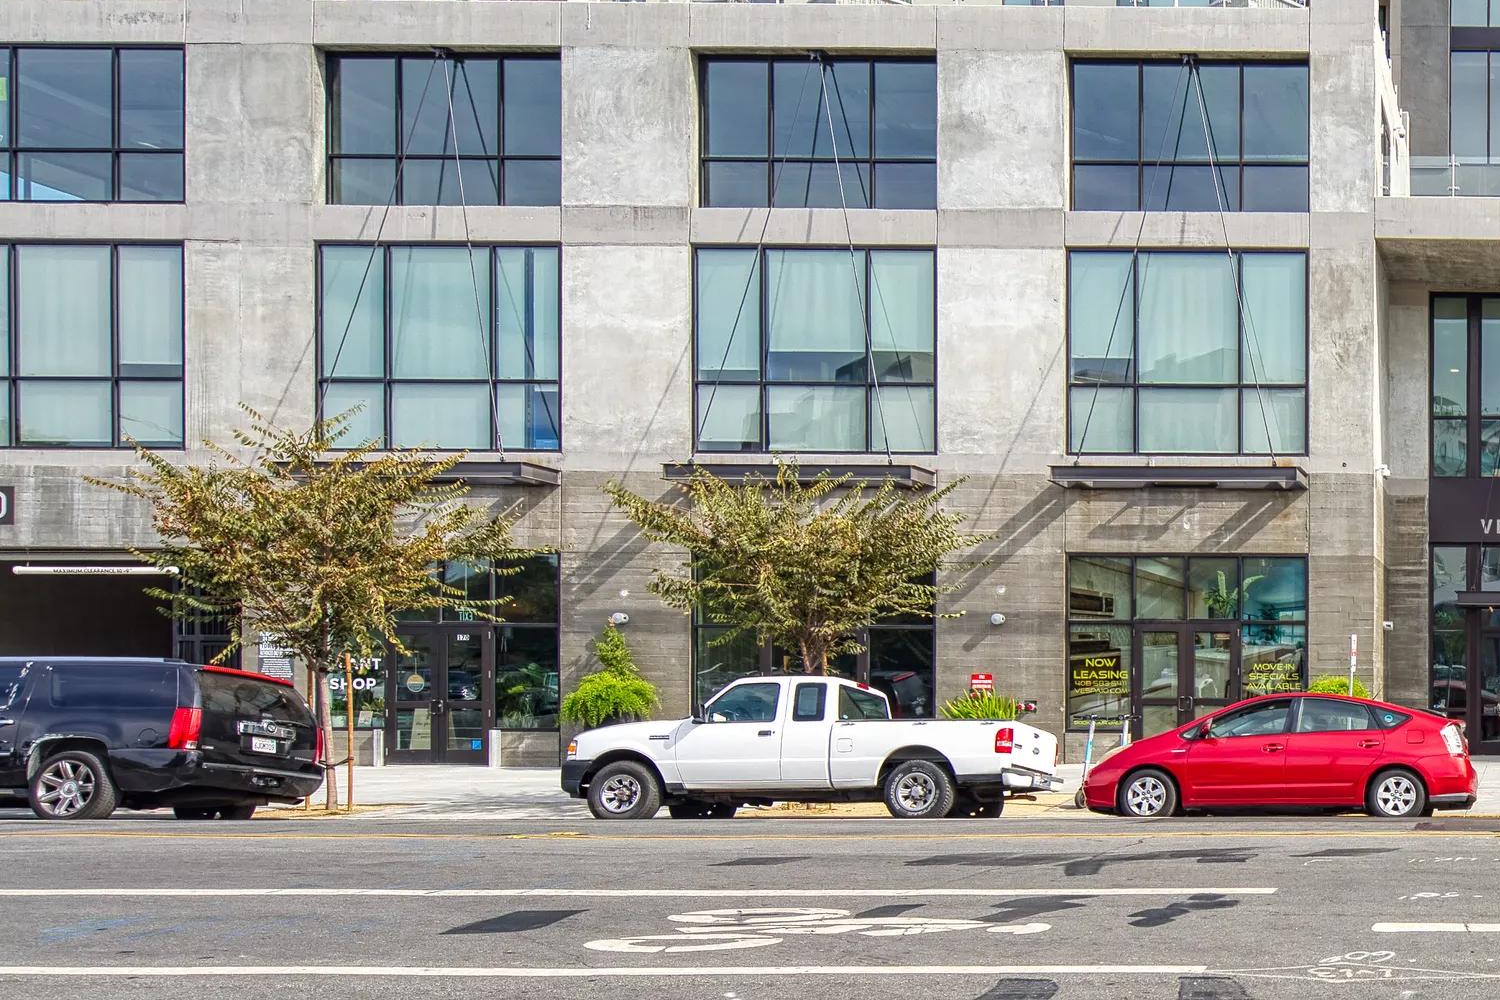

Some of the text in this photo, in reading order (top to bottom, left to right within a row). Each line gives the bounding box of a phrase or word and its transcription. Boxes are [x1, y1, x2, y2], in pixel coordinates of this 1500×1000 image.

[1085, 658, 1117, 667] NOW
[1252, 663, 1296, 671] MOVE-IN
[1073, 670, 1129, 679] LEASING
[330, 678, 377, 690] SHOP
[1247, 682, 1302, 690] AVAILABLE
